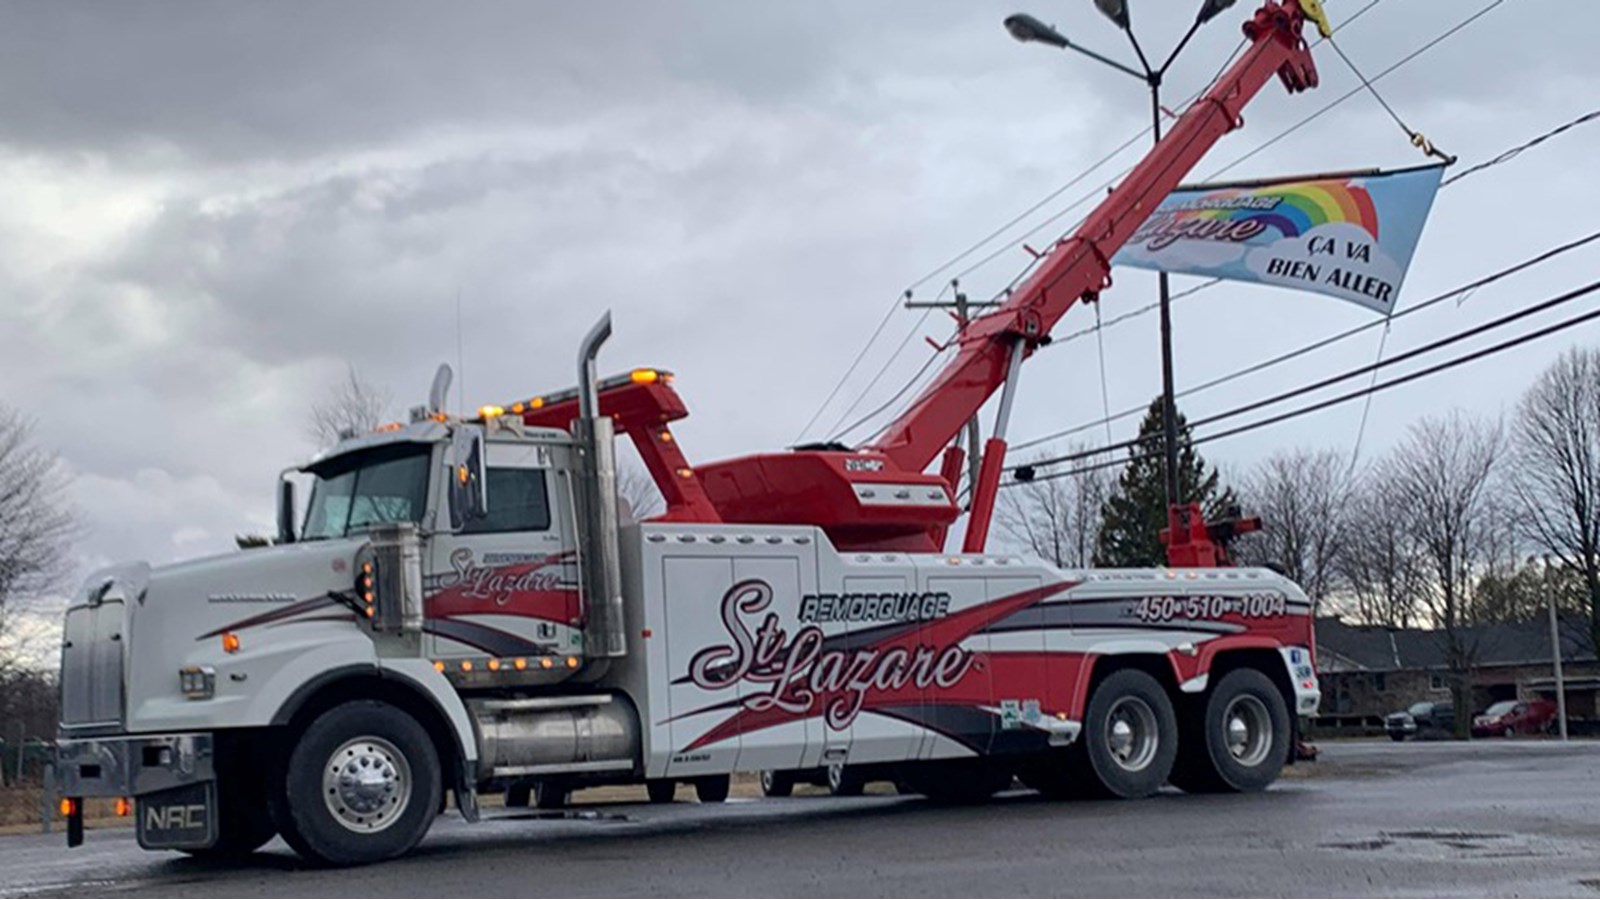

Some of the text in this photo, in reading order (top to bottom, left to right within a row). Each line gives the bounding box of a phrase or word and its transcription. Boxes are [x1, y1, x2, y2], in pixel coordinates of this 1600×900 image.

[1307, 235, 1370, 263] ÇA VA
[1266, 257, 1393, 302] BIEN ALLER
[797, 592, 951, 623] REMORQUAGE
[742, 626, 978, 731] Lazare
